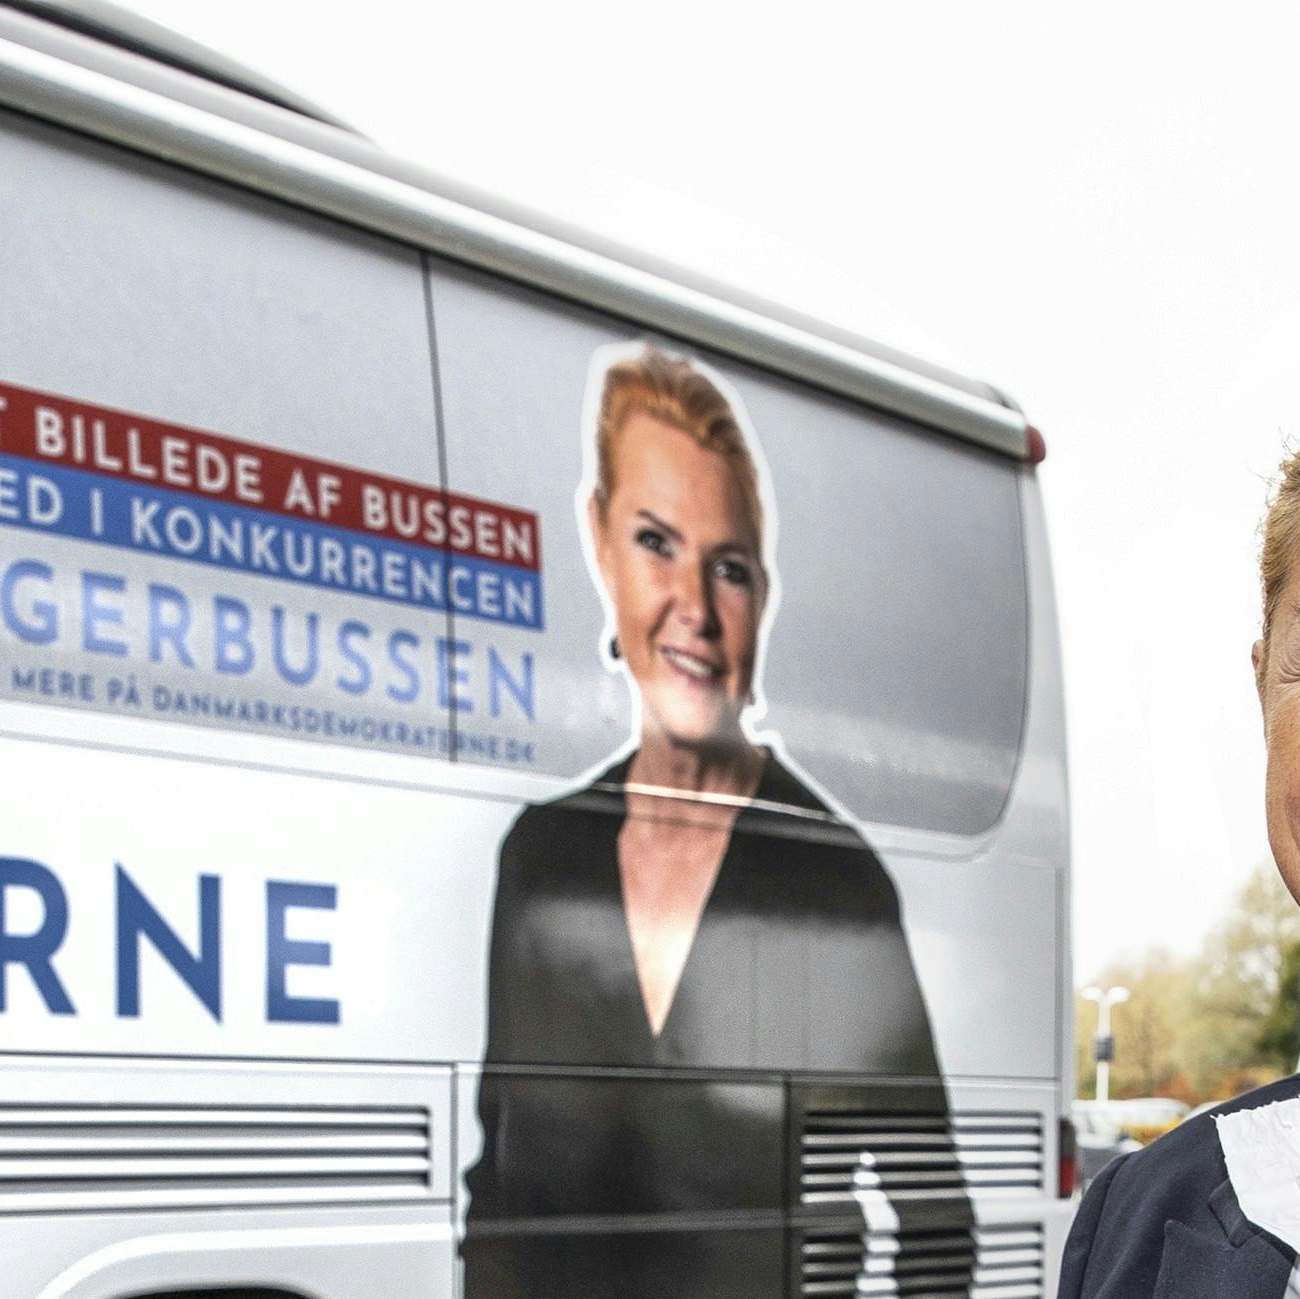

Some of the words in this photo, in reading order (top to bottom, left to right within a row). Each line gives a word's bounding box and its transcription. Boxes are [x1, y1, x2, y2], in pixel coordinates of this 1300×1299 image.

[34, 405, 263, 504] BILLEDE
[283, 468, 342, 519] AF
[361, 485, 534, 563] BUSSEN
[90, 487, 104, 536] I
[131, 497, 535, 622] KONKURRENCEN
[11, 665, 95, 702] MERE
[106, 672, 142, 708] PÅ
